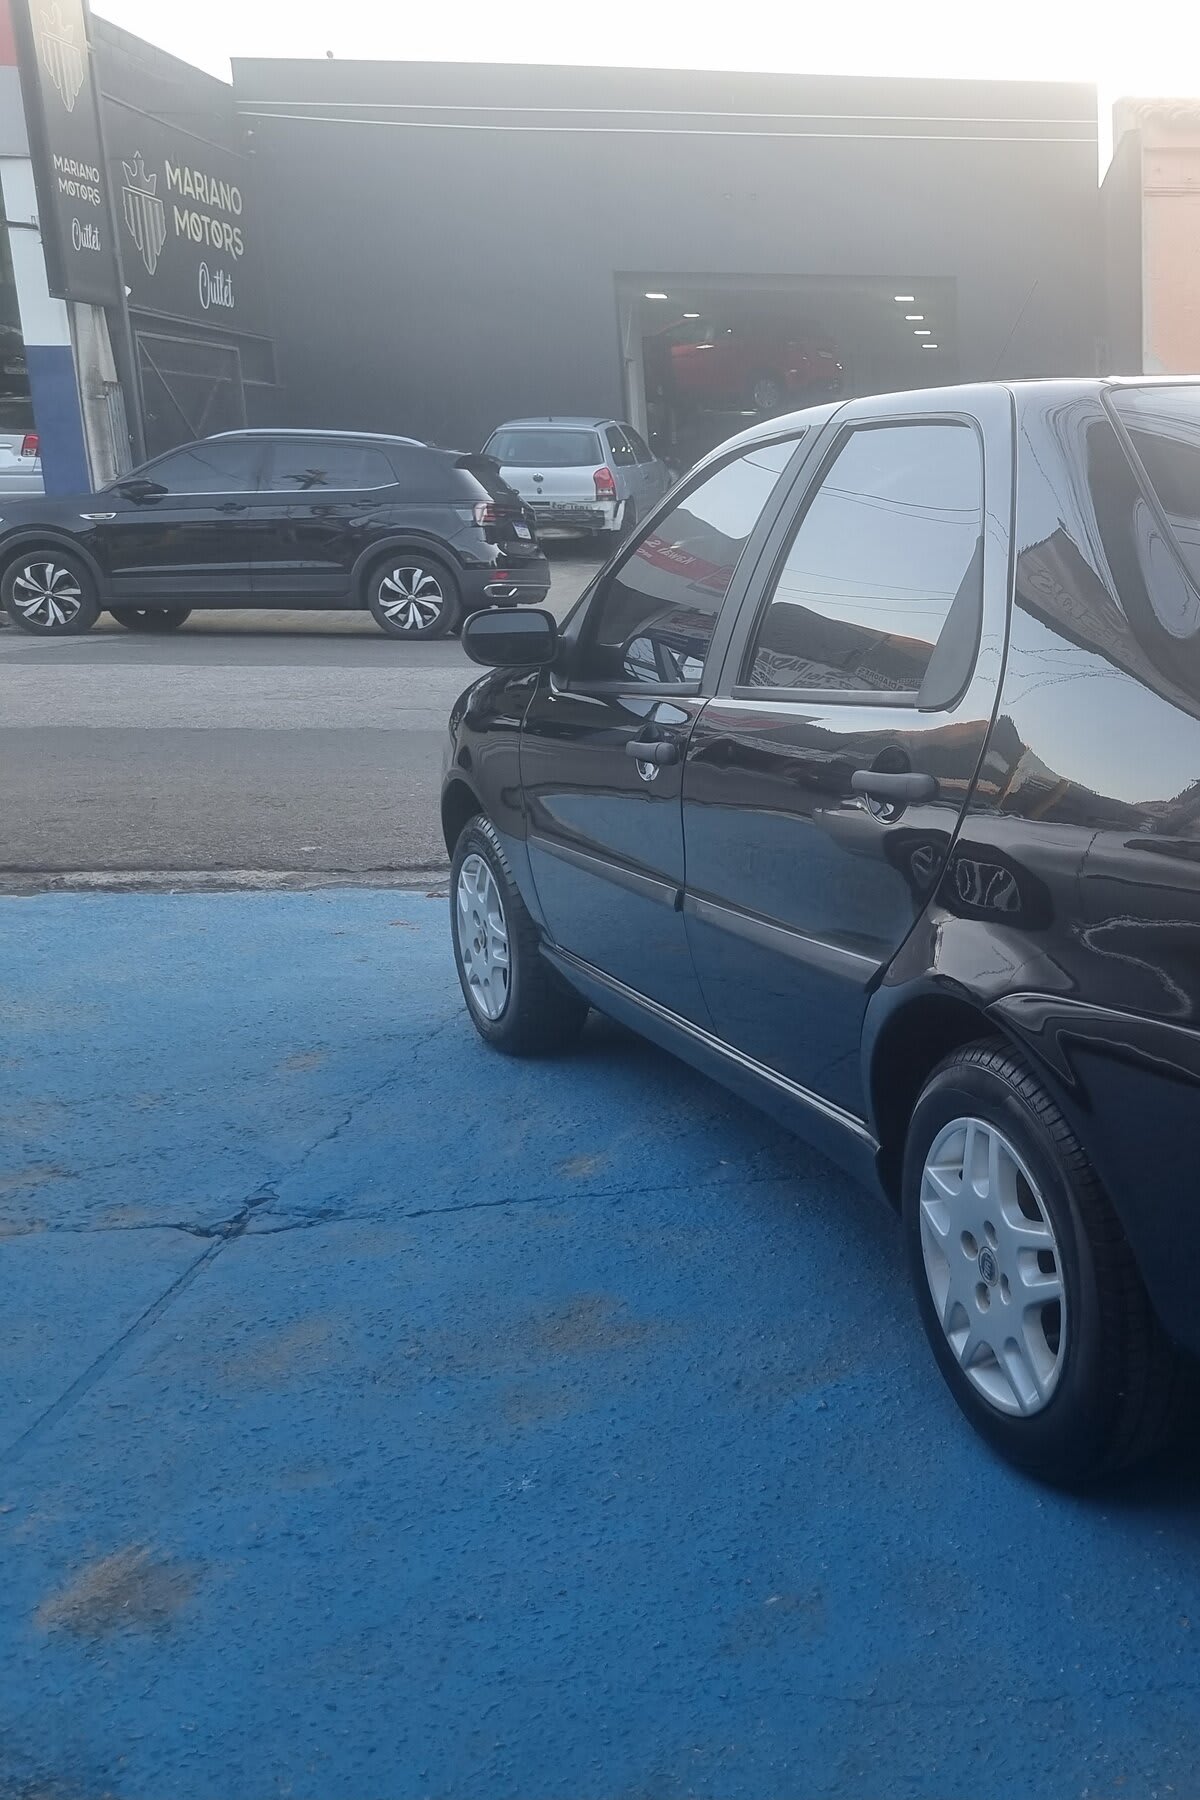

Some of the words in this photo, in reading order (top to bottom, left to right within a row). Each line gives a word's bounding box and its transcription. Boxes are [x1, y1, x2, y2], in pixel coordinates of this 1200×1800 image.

[53, 154, 100, 183] MARIANO
[164, 160, 243, 215] MARIANO
[58, 178, 100, 206] MOTORS
[72, 217, 101, 251] Outlet
[173, 205, 244, 260] MOTORS
[199, 261, 234, 309] Outlet
